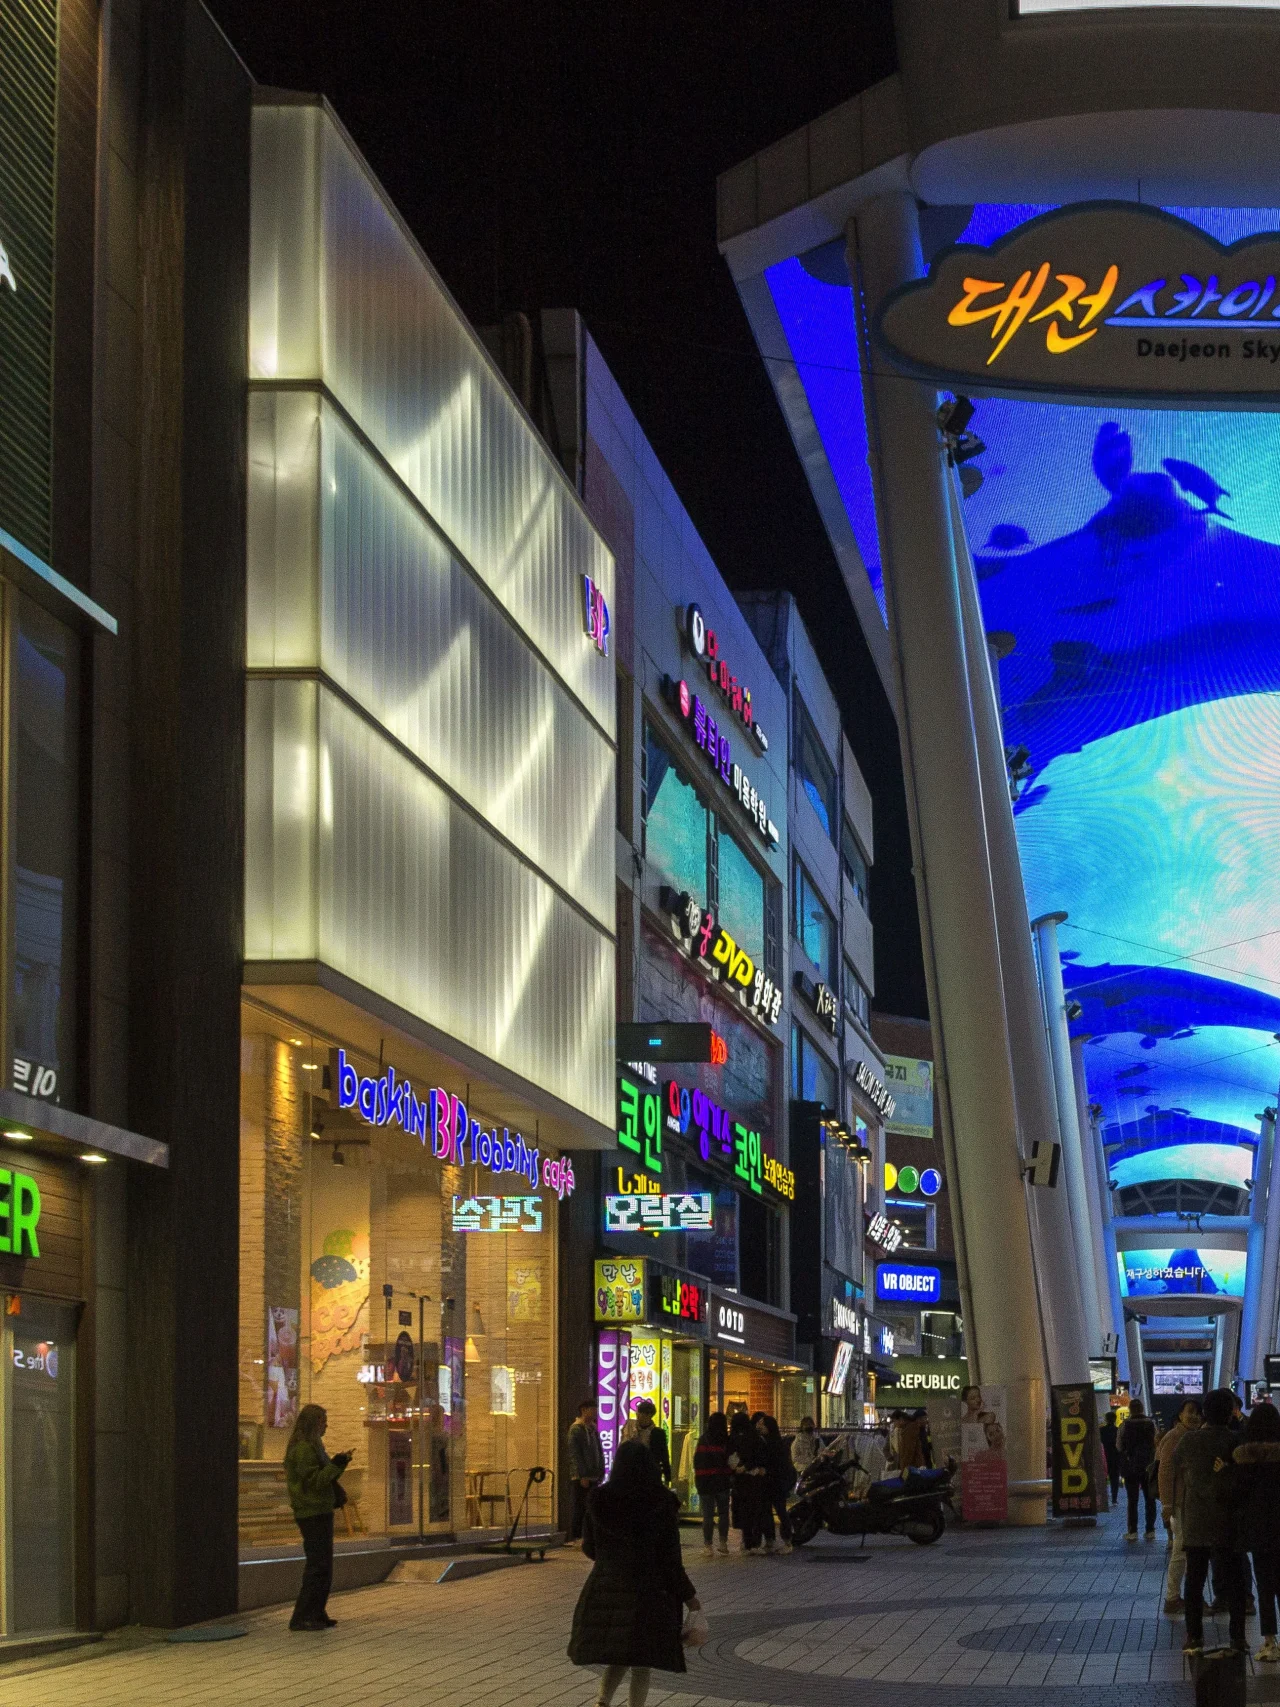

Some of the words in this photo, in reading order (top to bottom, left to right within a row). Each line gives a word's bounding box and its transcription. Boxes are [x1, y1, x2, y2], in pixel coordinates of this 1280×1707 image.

[946, 262, 1118, 366] 대전
[1136, 338, 1231, 361] Daejeon
[712, 930, 755, 987] DVD
[753, 969, 783, 1025] 영화관
[338, 1047, 428, 1147] baskin
[469, 1119, 540, 1191] robbins
[541, 1156, 576, 1201] café
[618, 1078, 662, 1174] 코인
[735, 1122, 762, 1195] 코인
[607, 1195, 713, 1231] 오락실
[602, 1263, 637, 1284] 만남
[883, 1272, 898, 1290] VR
[899, 1273, 936, 1292] OBJECT
[718, 1306, 744, 1333] OOTD
[598, 1343, 617, 1422] DVD
[896, 1373, 960, 1390] REPUBLIC
[1060, 1416, 1088, 1495] DVD
